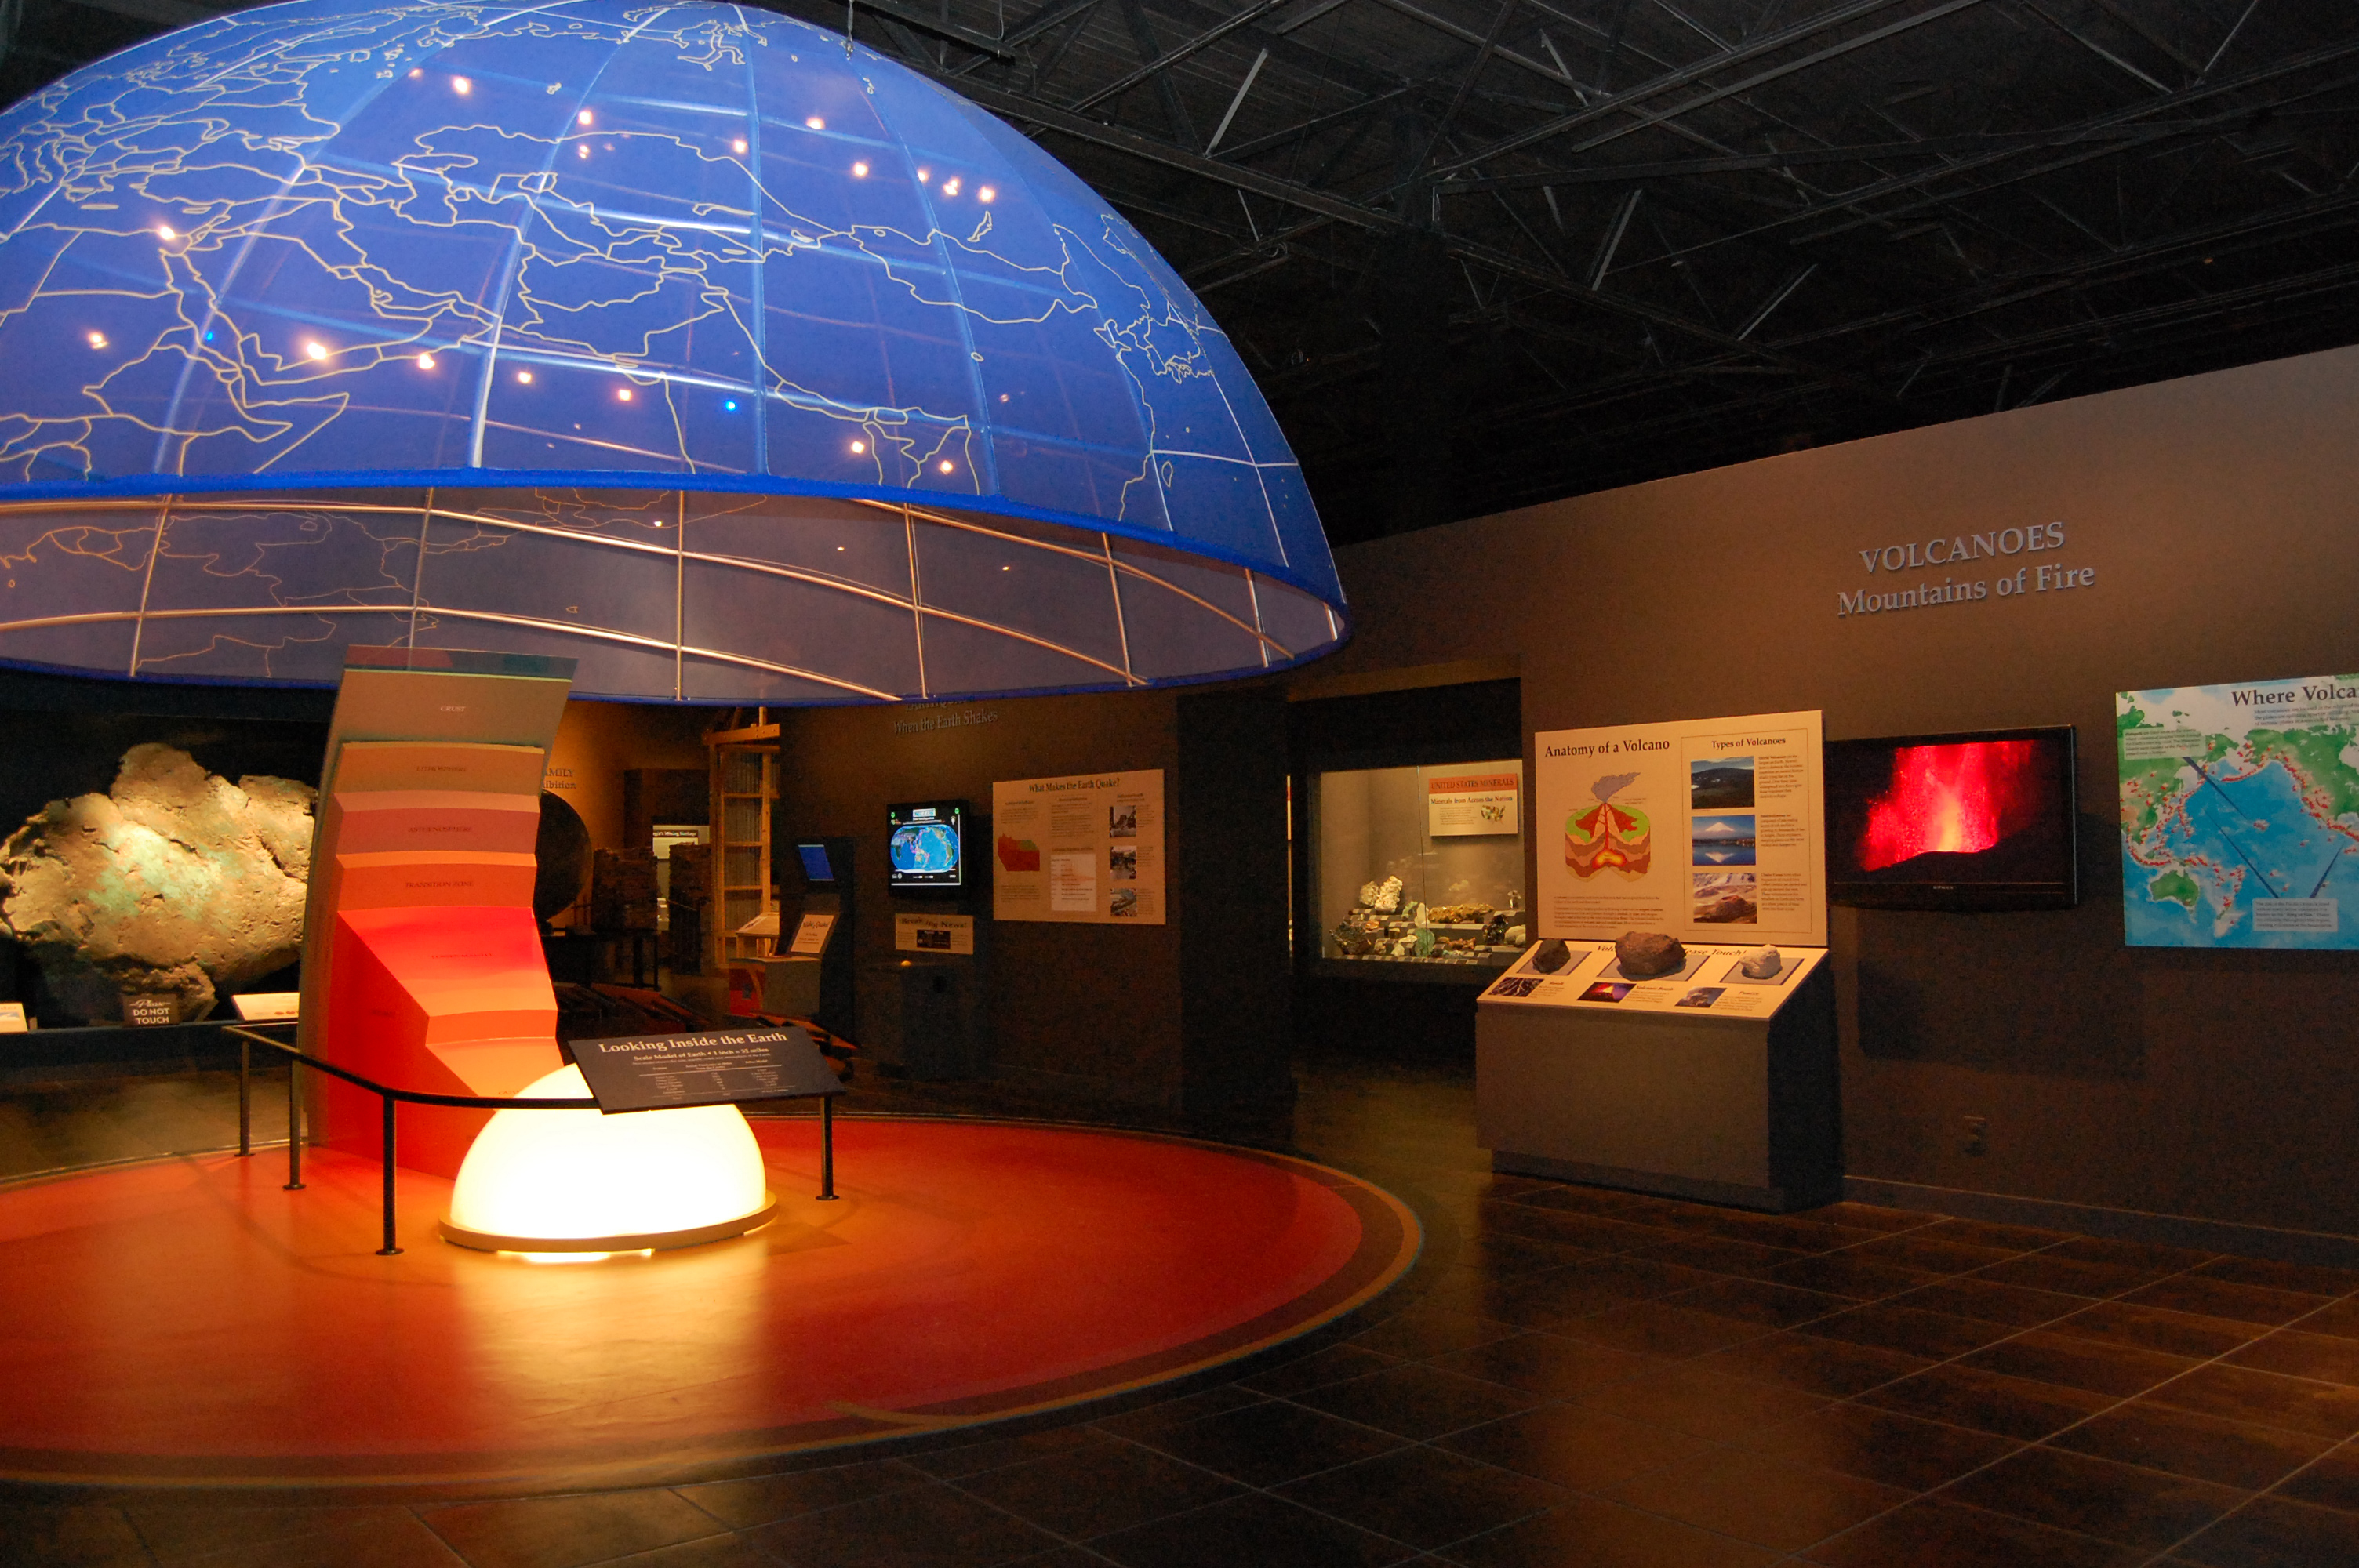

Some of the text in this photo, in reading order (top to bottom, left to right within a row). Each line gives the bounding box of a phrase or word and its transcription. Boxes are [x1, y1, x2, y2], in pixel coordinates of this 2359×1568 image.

[1859, 521, 2065, 573] VOLCANOES
[1837, 562, 2095, 617] Mountains of Fire
[2231, 683, 2358, 706] Where Volca
[893, 708, 999, 735] When the Earth Shakes
[1544, 739, 1670, 758] Anatomy of a Volcano
[1710, 740, 1734, 750] Types
[1746, 737, 1787, 746] Volcanoes
[546, 768, 574, 777] MILY
[544, 780, 576, 789] ibition
[1029, 778, 1120, 792] What Makes the Earth Quake?
[1456, 780, 1479, 789] STATES
[1480, 779, 1514, 787] MINERALS
[133, 1008, 147, 1017] DO
[598, 1032, 789, 1054] Looking Inside the Earth
